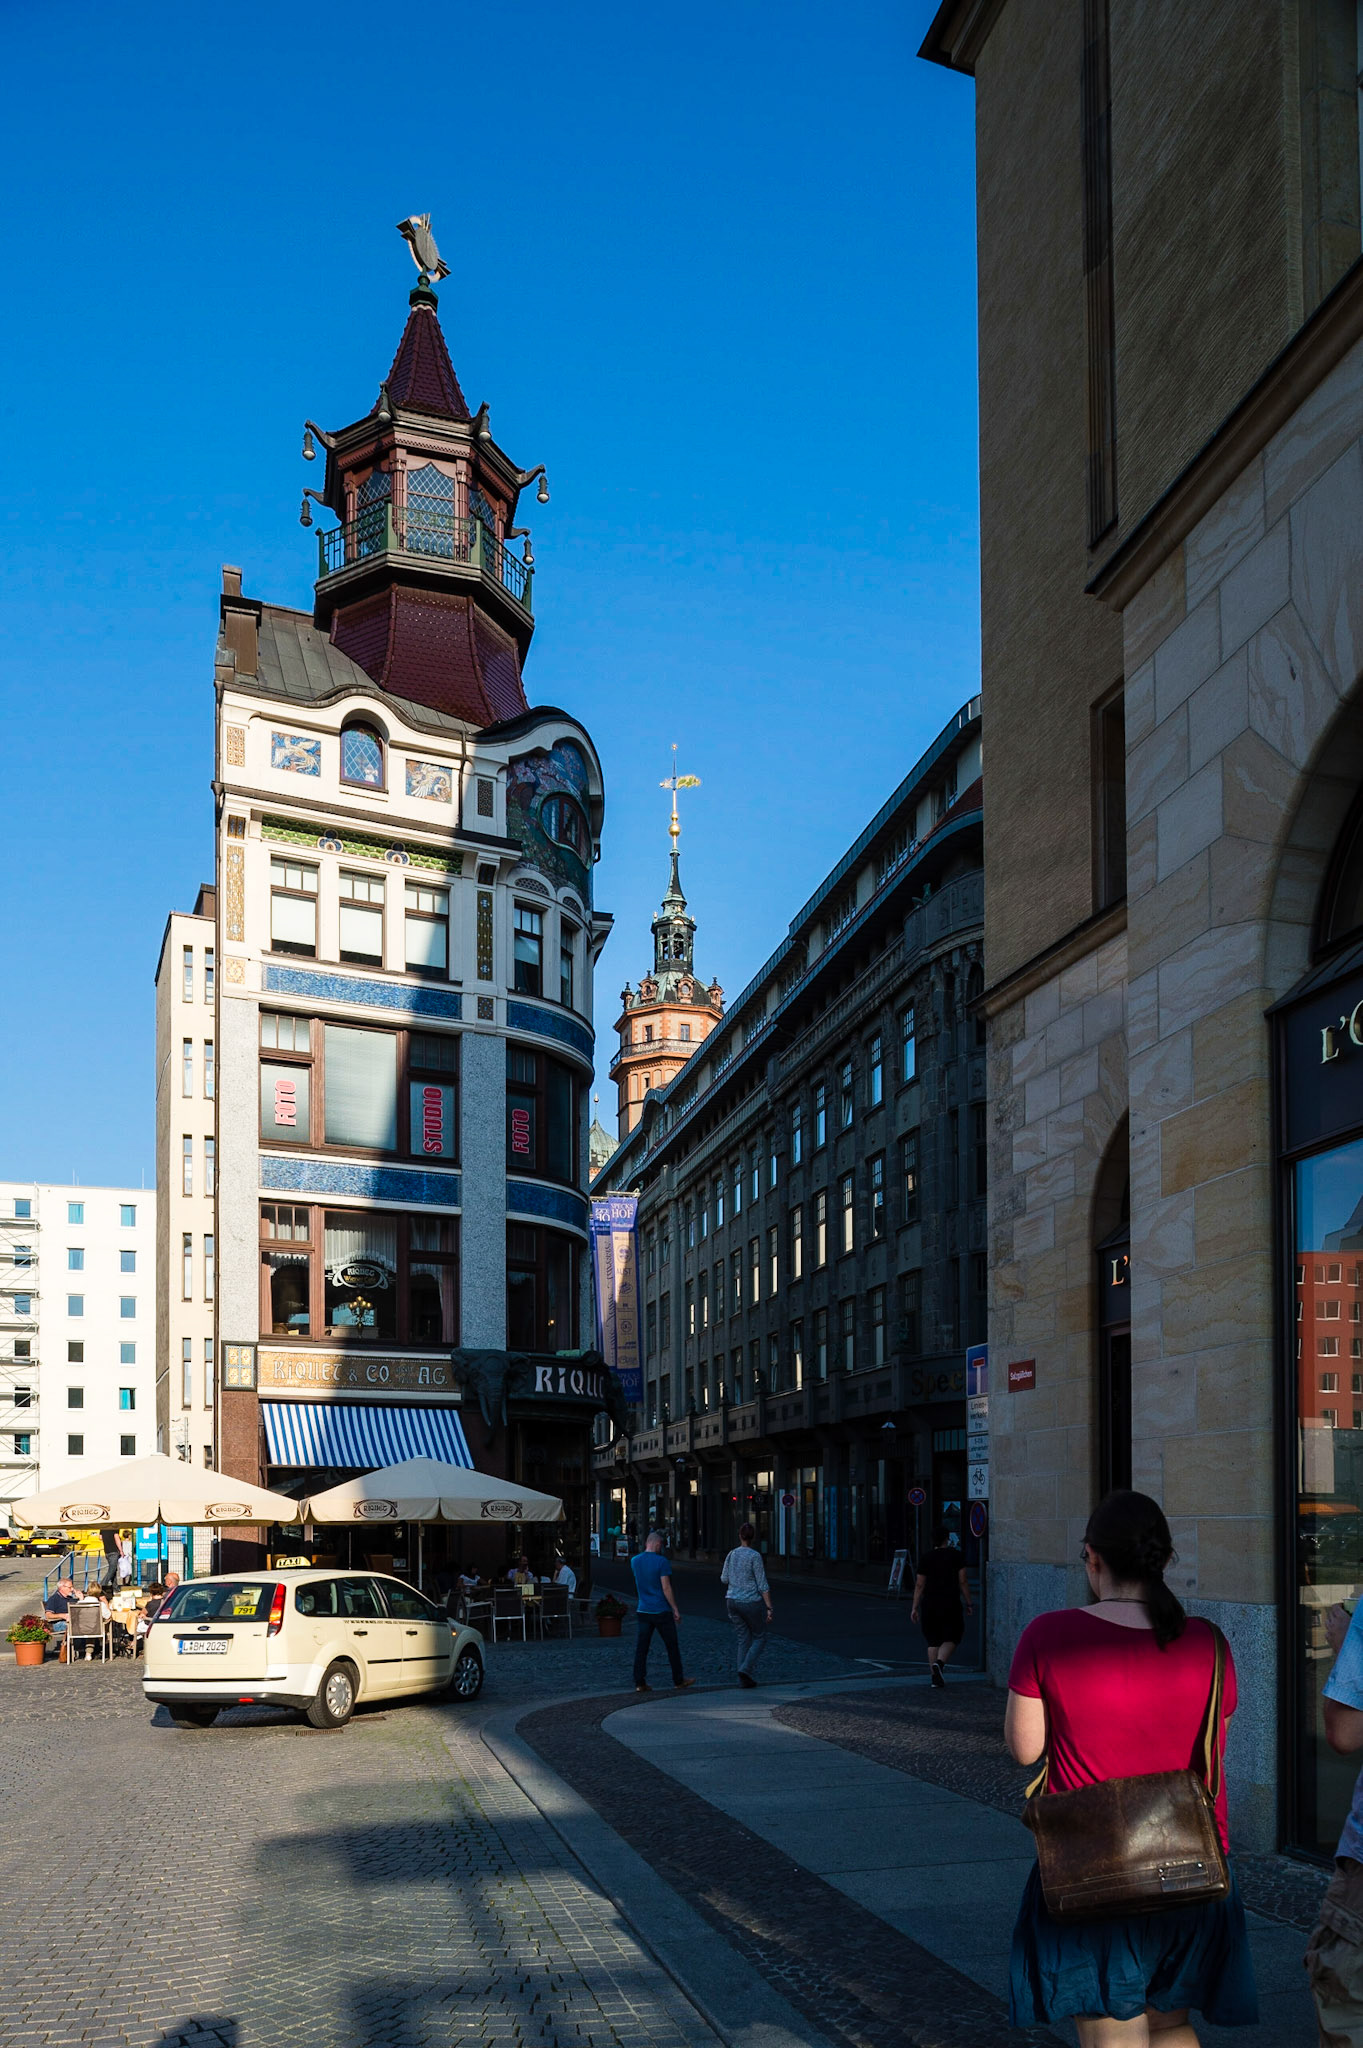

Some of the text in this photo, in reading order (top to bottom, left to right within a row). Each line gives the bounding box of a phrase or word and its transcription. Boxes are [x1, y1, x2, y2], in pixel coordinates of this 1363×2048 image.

[275, 1079, 297, 1126] FOTO
[423, 1086, 443, 1153] STUDIO
[512, 1108, 530, 1154] FOTO
[612, 1209, 634, 1219] HOF
[279, 1557, 301, 1567] TAXI
[238, 1606, 254, 1614] 791
[206, 1641, 227, 1651] 2025
